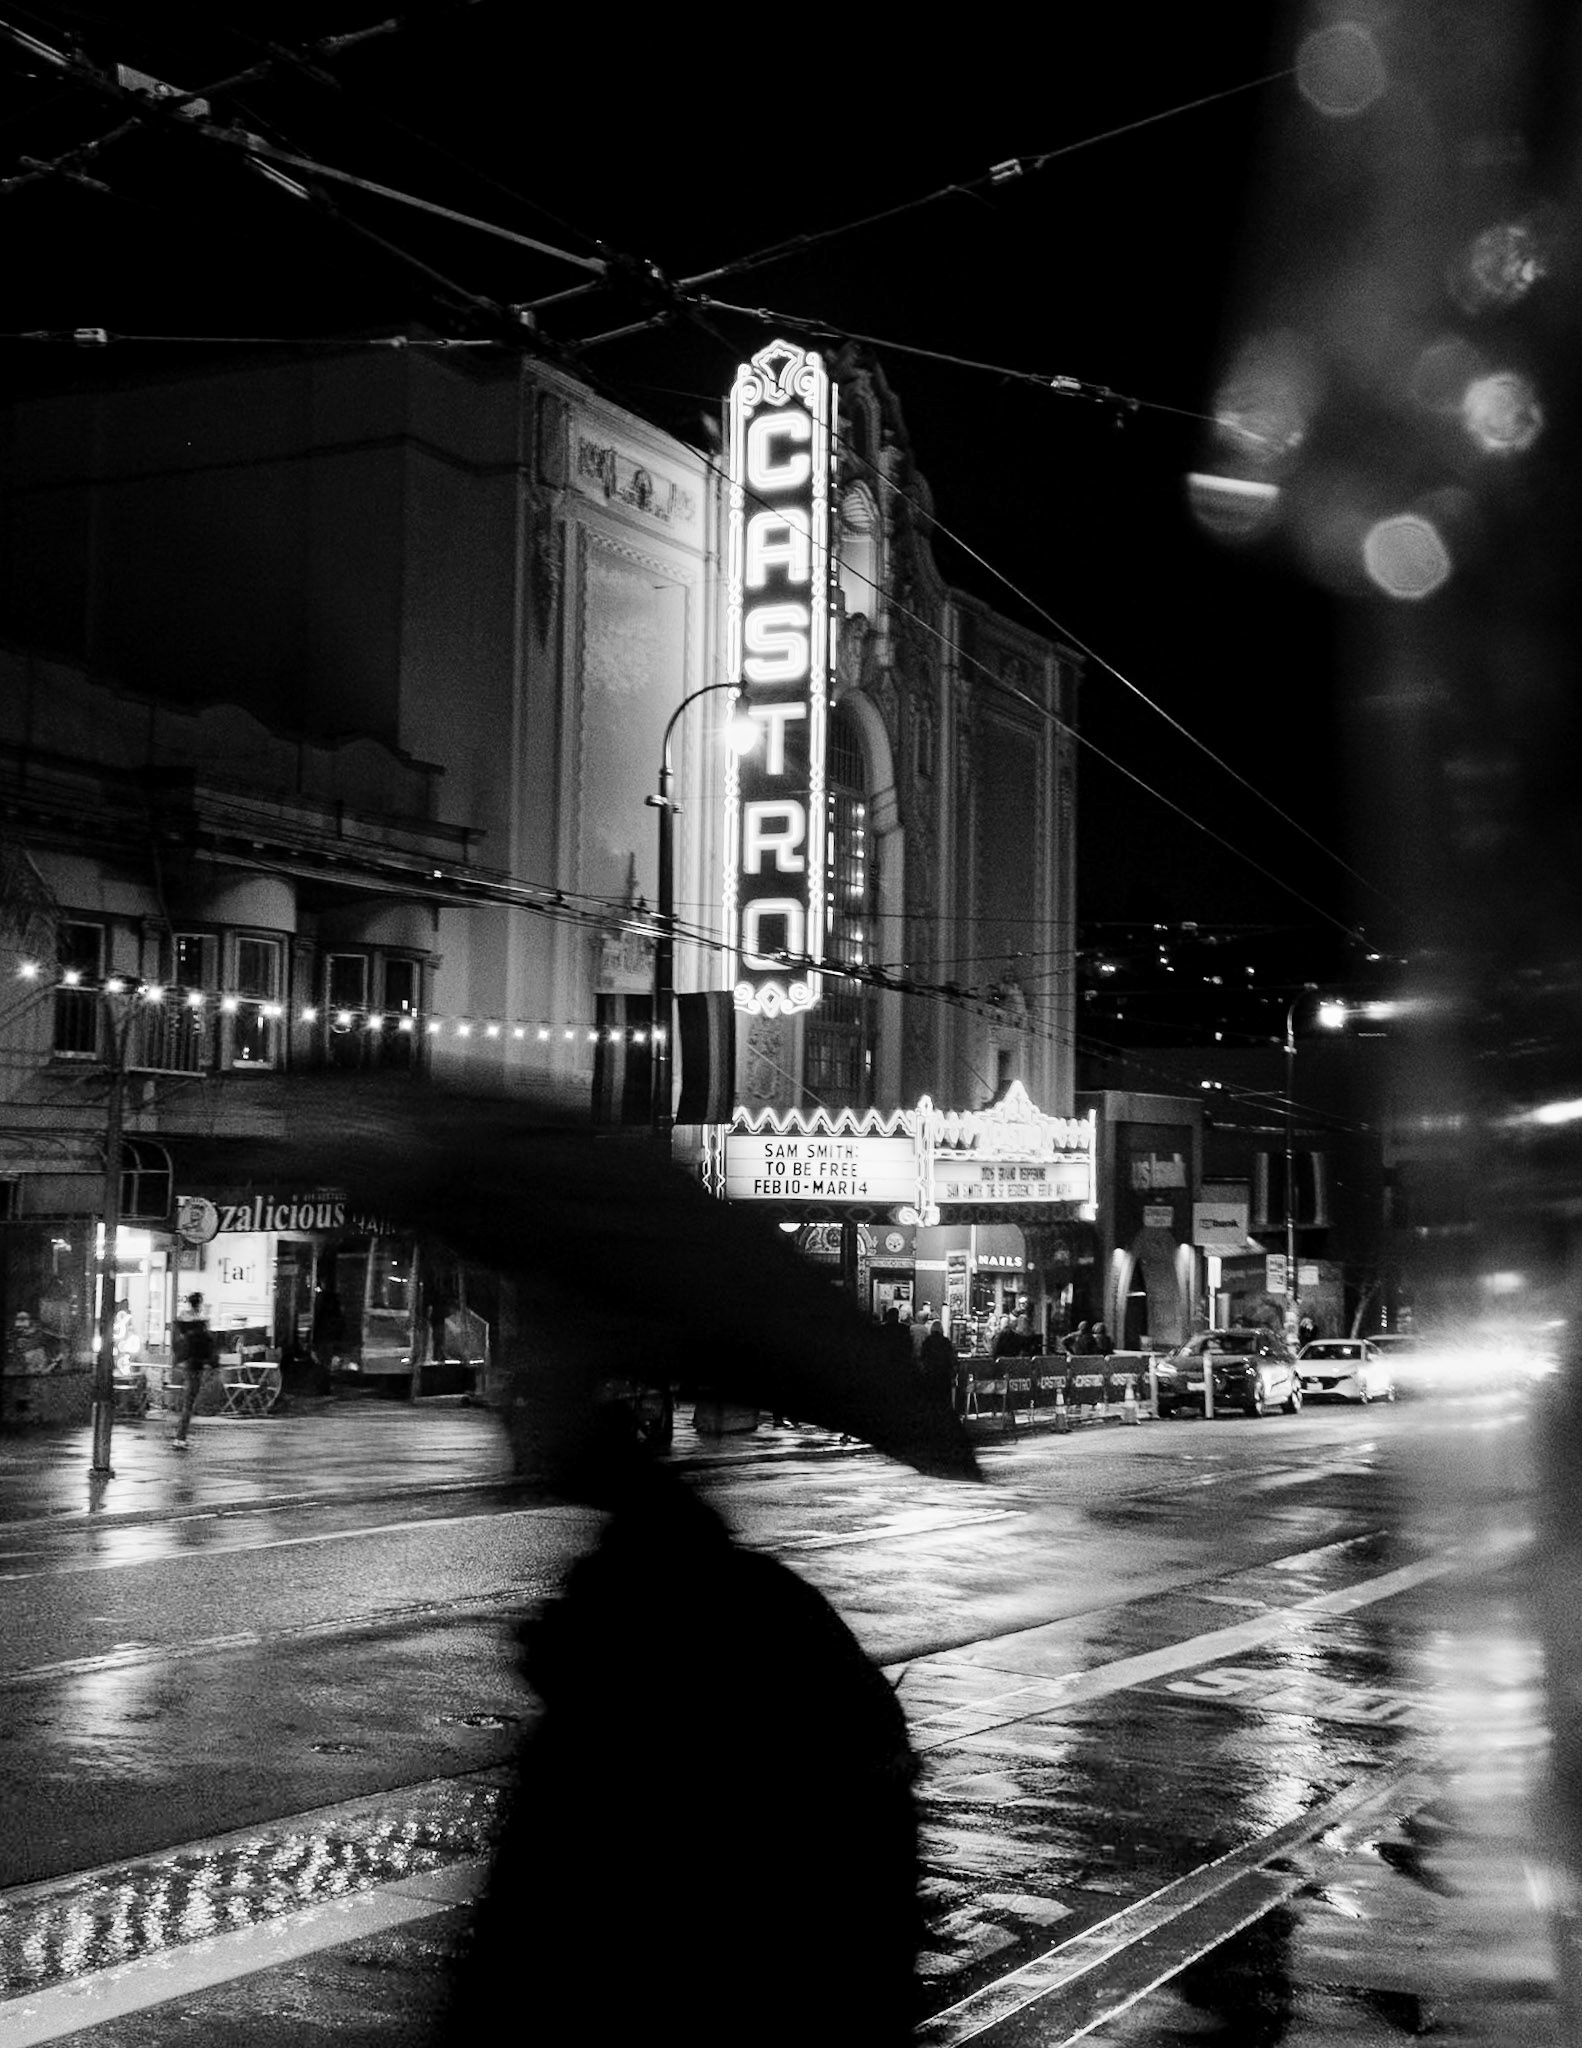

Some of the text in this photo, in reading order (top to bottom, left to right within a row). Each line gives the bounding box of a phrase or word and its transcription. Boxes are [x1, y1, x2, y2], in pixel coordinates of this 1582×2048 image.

[742, 409, 812, 971] CASTRO
[764, 1143, 798, 1158] SAM
[765, 1161, 857, 1177] TO BE FREE
[175, 1195, 345, 1233] zalicious
[977, 1254, 1024, 1268] NAILS
